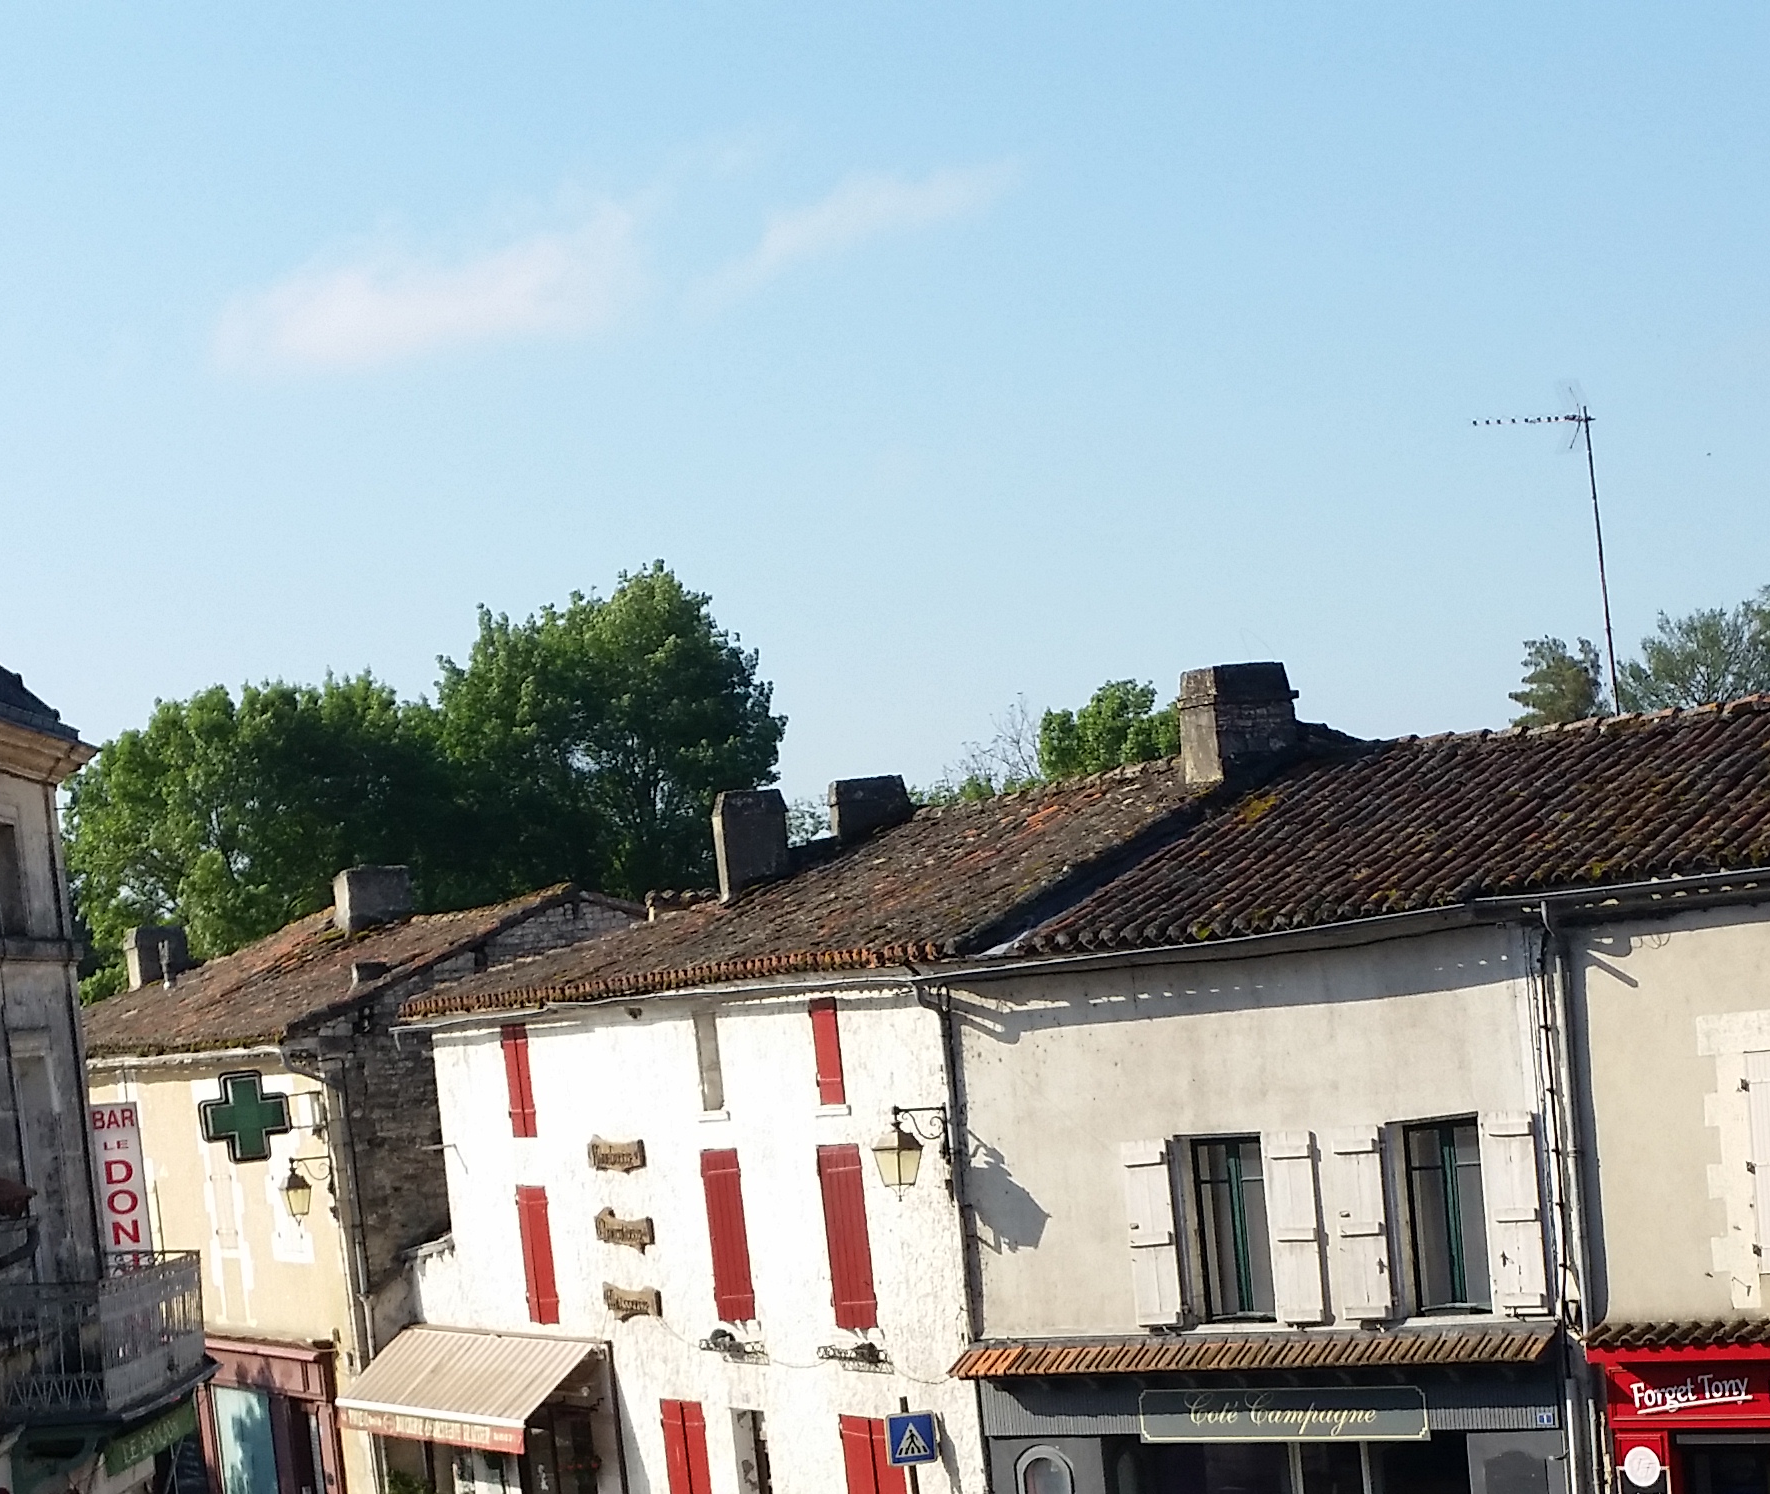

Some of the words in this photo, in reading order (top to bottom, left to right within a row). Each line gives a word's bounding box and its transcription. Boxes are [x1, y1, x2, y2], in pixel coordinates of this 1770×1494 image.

[92, 1108, 135, 1130] BAR
[103, 1139, 130, 1151] LE
[1630, 1377, 1697, 1412] Forget
[1698, 1373, 1749, 1398] Tony
[1244, 1391, 1378, 1436] Campagne
